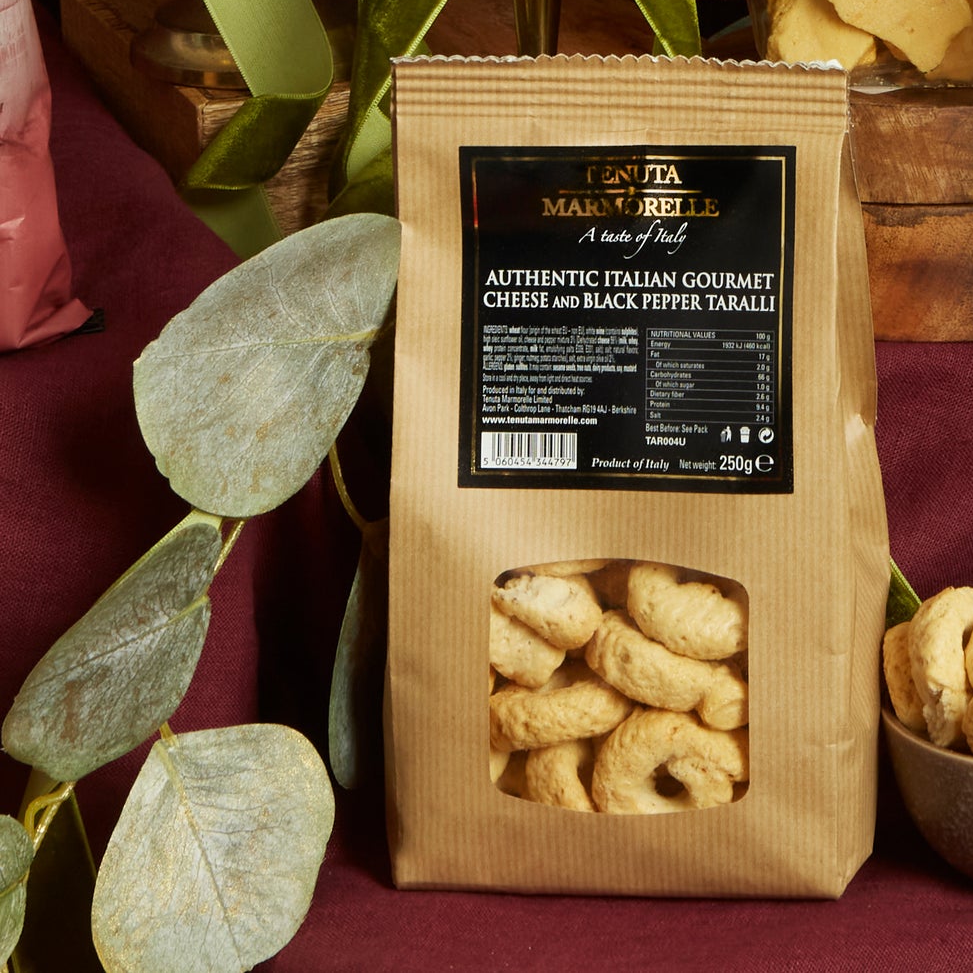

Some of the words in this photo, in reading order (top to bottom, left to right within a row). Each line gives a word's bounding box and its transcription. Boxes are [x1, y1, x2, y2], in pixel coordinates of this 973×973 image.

[586, 165, 682, 184] TENUTA
[542, 197, 720, 217] MARMORELLE
[578, 227, 595, 243] A
[601, 228, 632, 243] taste
[623, 220, 653, 259] of
[654, 222, 687, 255] Italy
[485, 270, 599, 287] AUTHENTIC
[604, 271, 676, 288] ITALIAN
[681, 272, 775, 290] GOURMET
[483, 291, 549, 309] CHEESE
[552, 295, 580, 309] AND
[583, 293, 639, 310] BLACK
[642, 293, 700, 310] PEPPER
[705, 294, 776, 312] TARALLI
[650, 371, 692, 379] Carbohydrates
[483, 386, 508, 394] Produced
[516, 387, 527, 396] Italy
[548, 387, 576, 395] distributed
[612, 406, 637, 414] Berkshire
[482, 416, 598, 425] www.tenutamarmorelle.com
[646, 424, 659, 432] Best
[660, 424, 680, 432] Before:
[682, 425, 692, 433] See
[694, 425, 708, 433] Pack
[646, 436, 686, 446] TAR004U
[592, 458, 630, 468] Product
[633, 459, 644, 471] of
[645, 459, 669, 471] Italy
[680, 460, 691, 469] Net
[692, 460, 716, 472] weight:
[720, 455, 752, 474] 250g
